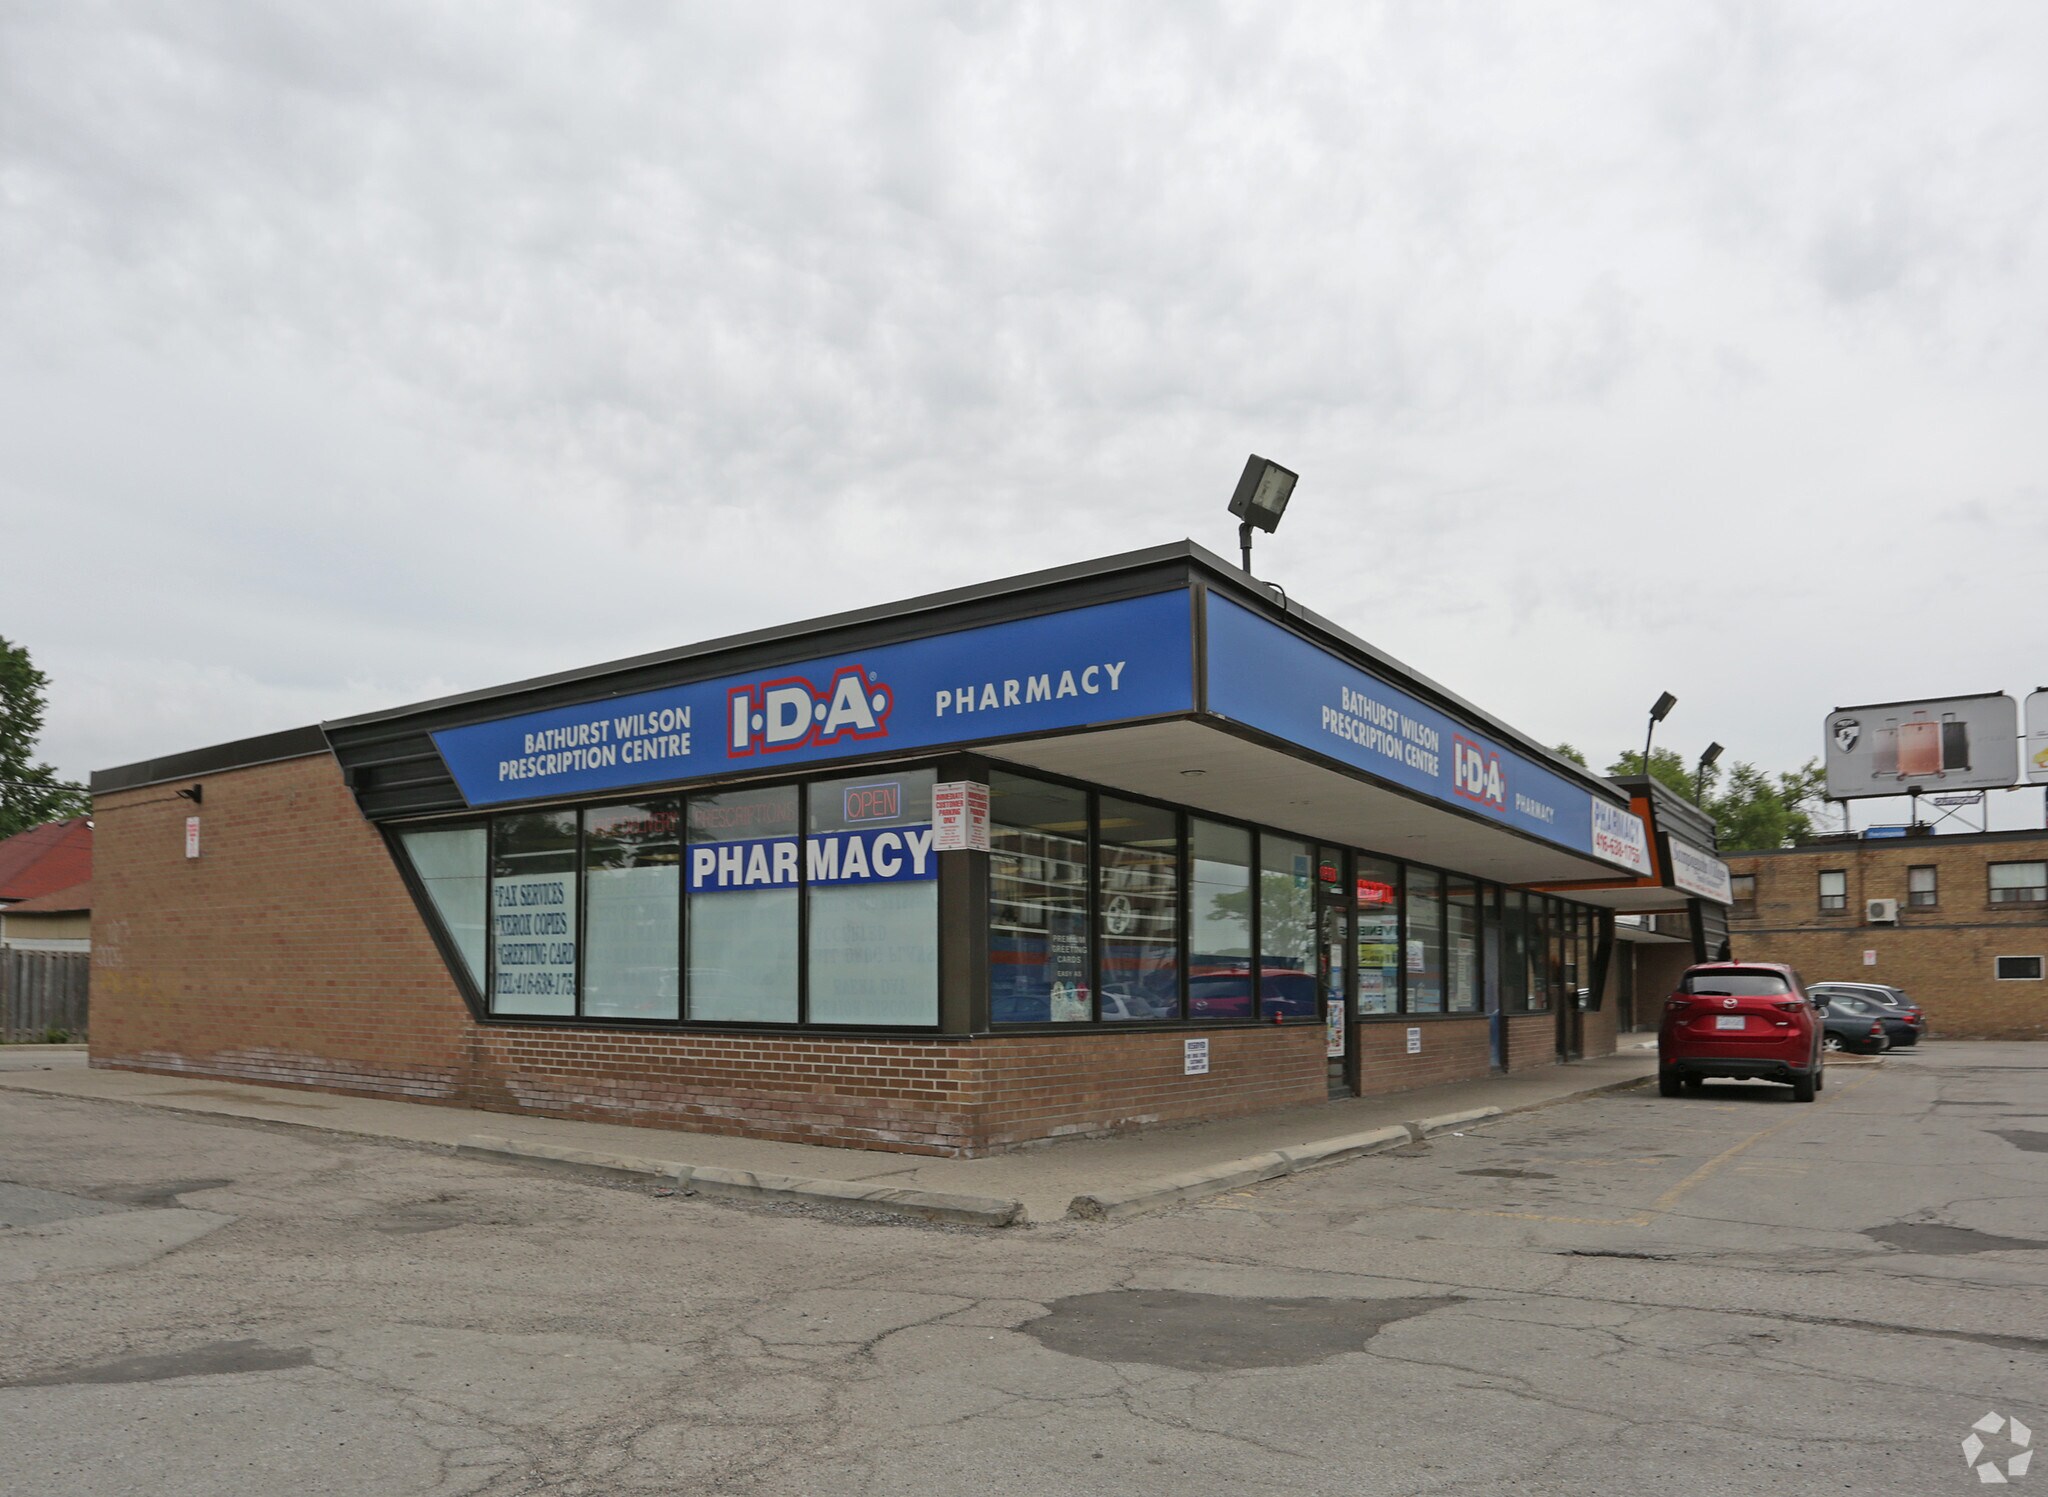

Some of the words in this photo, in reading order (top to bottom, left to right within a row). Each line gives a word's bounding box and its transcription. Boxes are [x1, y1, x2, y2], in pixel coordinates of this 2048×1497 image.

[936, 661, 1126, 717] PHARMACY
[524, 719, 610, 754] BATHURST
[614, 705, 691, 739] WILSON
[1342, 686, 1398, 733] BATHURST
[1401, 715, 1439, 752] WILSON
[499, 744, 617, 781] PRESCRIPTION
[621, 732, 691, 764] CENTRE
[1322, 705, 1403, 761] PRESCRIPTION
[1405, 743, 1439, 777] CENTRE
[848, 788, 898, 818] OPEN
[1515, 792, 1555, 824] PHARMACY
[693, 830, 933, 888] PHARMACY
[520, 881, 565, 906] SERVICES
[499, 913, 532, 937] XEROX
[534, 911, 567, 936] COPIES
[501, 943, 547, 965] GREETING
[1052, 945, 1087, 954] GREETING
[1057, 955, 1082, 964] CARDS
